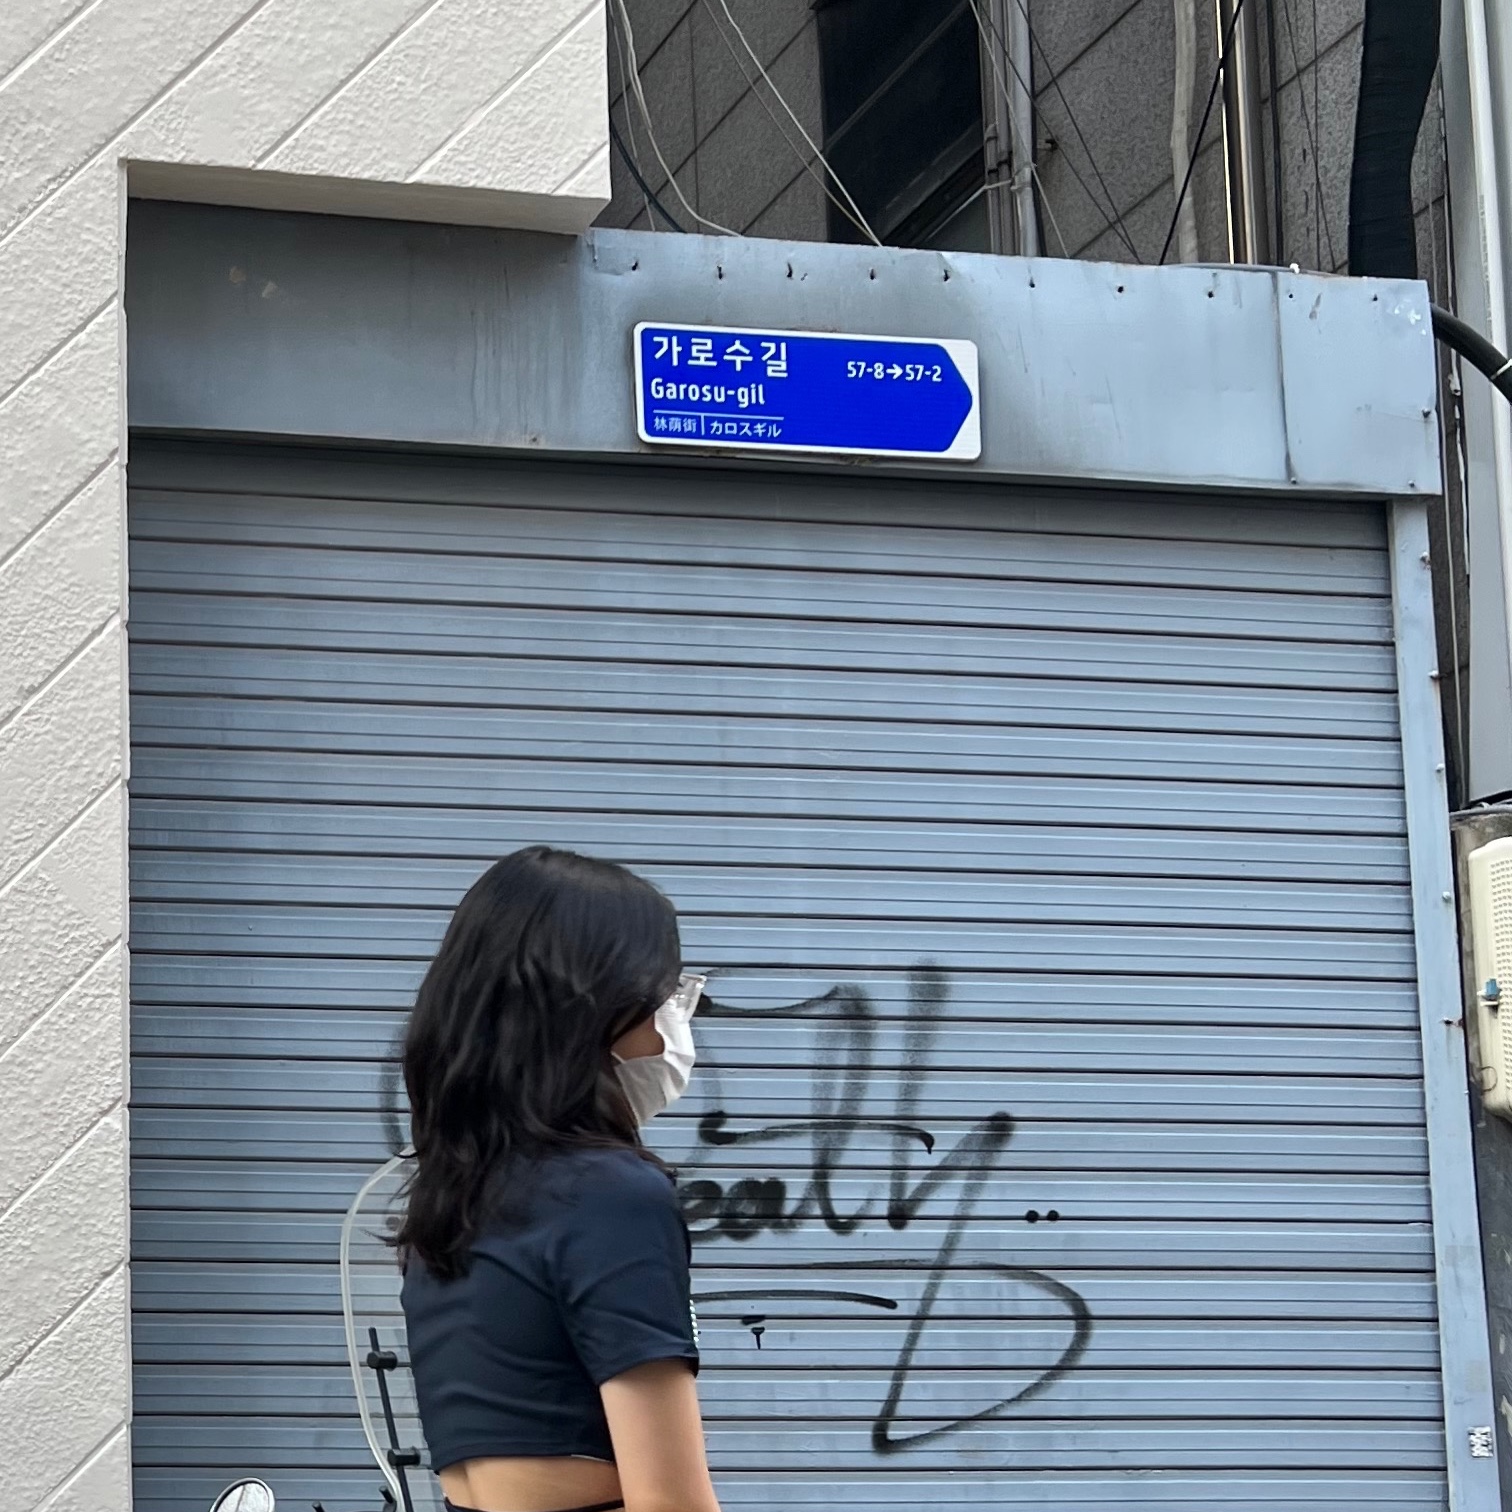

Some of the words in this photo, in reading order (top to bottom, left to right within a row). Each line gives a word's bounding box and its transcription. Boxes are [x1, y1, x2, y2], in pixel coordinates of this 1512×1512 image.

[652, 335, 789, 378] 가로수길
[650, 377, 766, 408] Garosu-gil
[709, 420, 783, 439] カロスギル
